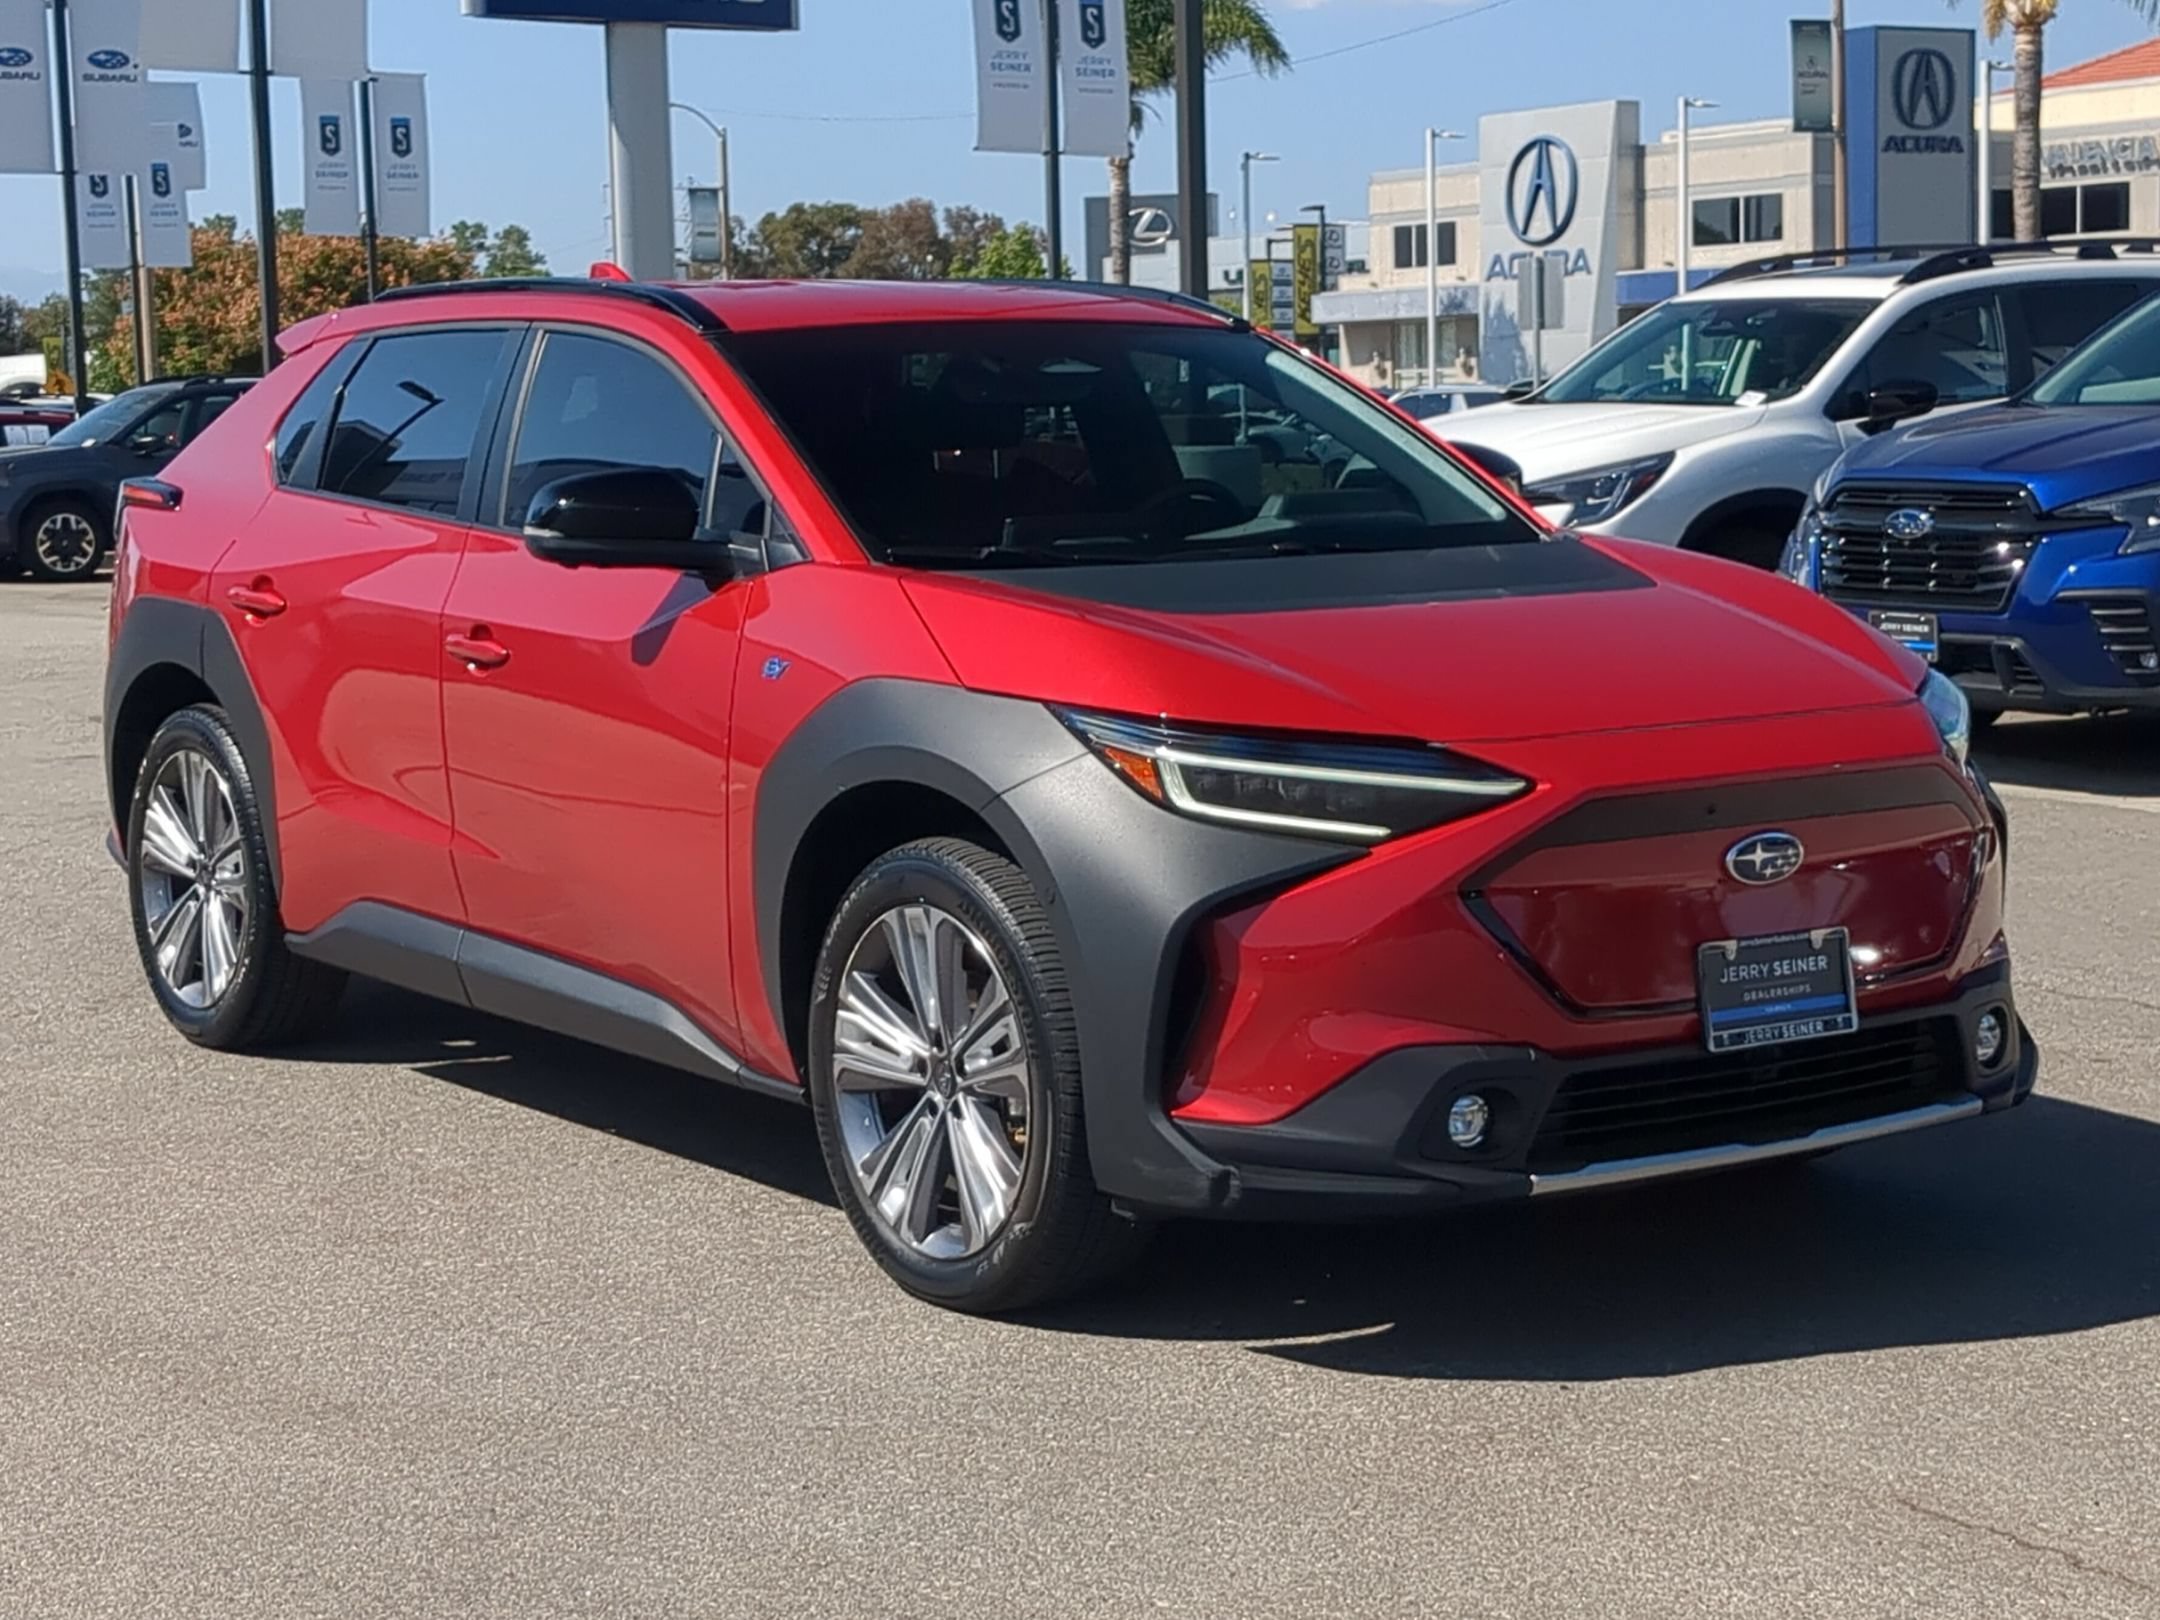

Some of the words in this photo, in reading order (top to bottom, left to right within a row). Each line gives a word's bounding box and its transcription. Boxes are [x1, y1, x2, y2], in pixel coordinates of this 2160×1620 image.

[0, 71, 41, 81] UBARU
[990, 61, 1032, 73] SEINER
[1075, 66, 1116, 78] SEINER
[82, 73, 138, 83] SUBARU
[1881, 134, 1965, 154] ACURA
[1484, 247, 1593, 281] ACRA
[1719, 962, 1770, 984] JERRY
[1773, 954, 1829, 977] SEINER
[1743, 983, 1812, 1002] DEALERSHIPS
[1743, 1028, 1780, 1045] JERRY
[1781, 1021, 1825, 1039] SEINER
